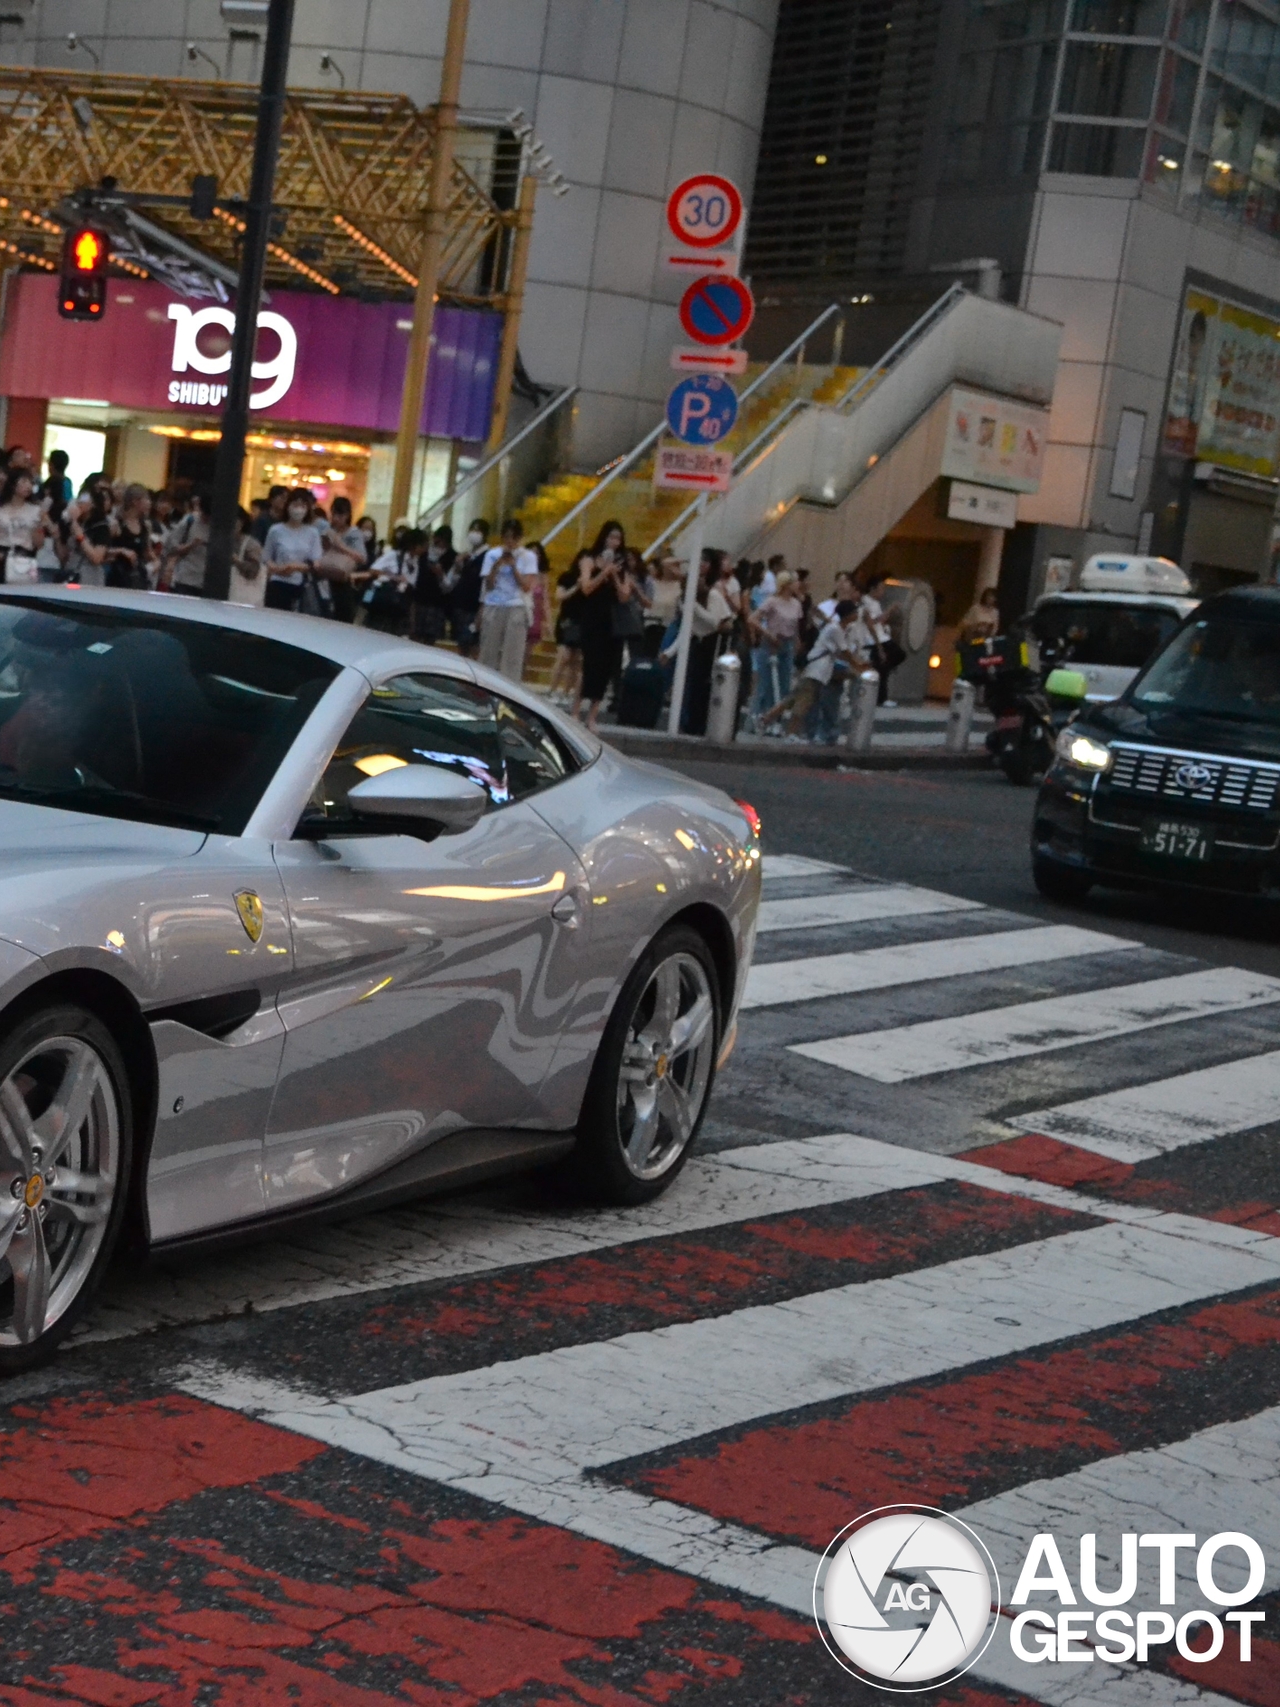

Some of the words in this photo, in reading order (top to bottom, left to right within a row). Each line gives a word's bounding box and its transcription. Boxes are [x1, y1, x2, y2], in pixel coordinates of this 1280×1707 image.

[684, 195, 726, 228] 30
[167, 303, 298, 410] 109
[167, 380, 229, 407] SHIBU
[680, 391, 712, 437] P
[1154, 832, 1207, 860] 51-71
